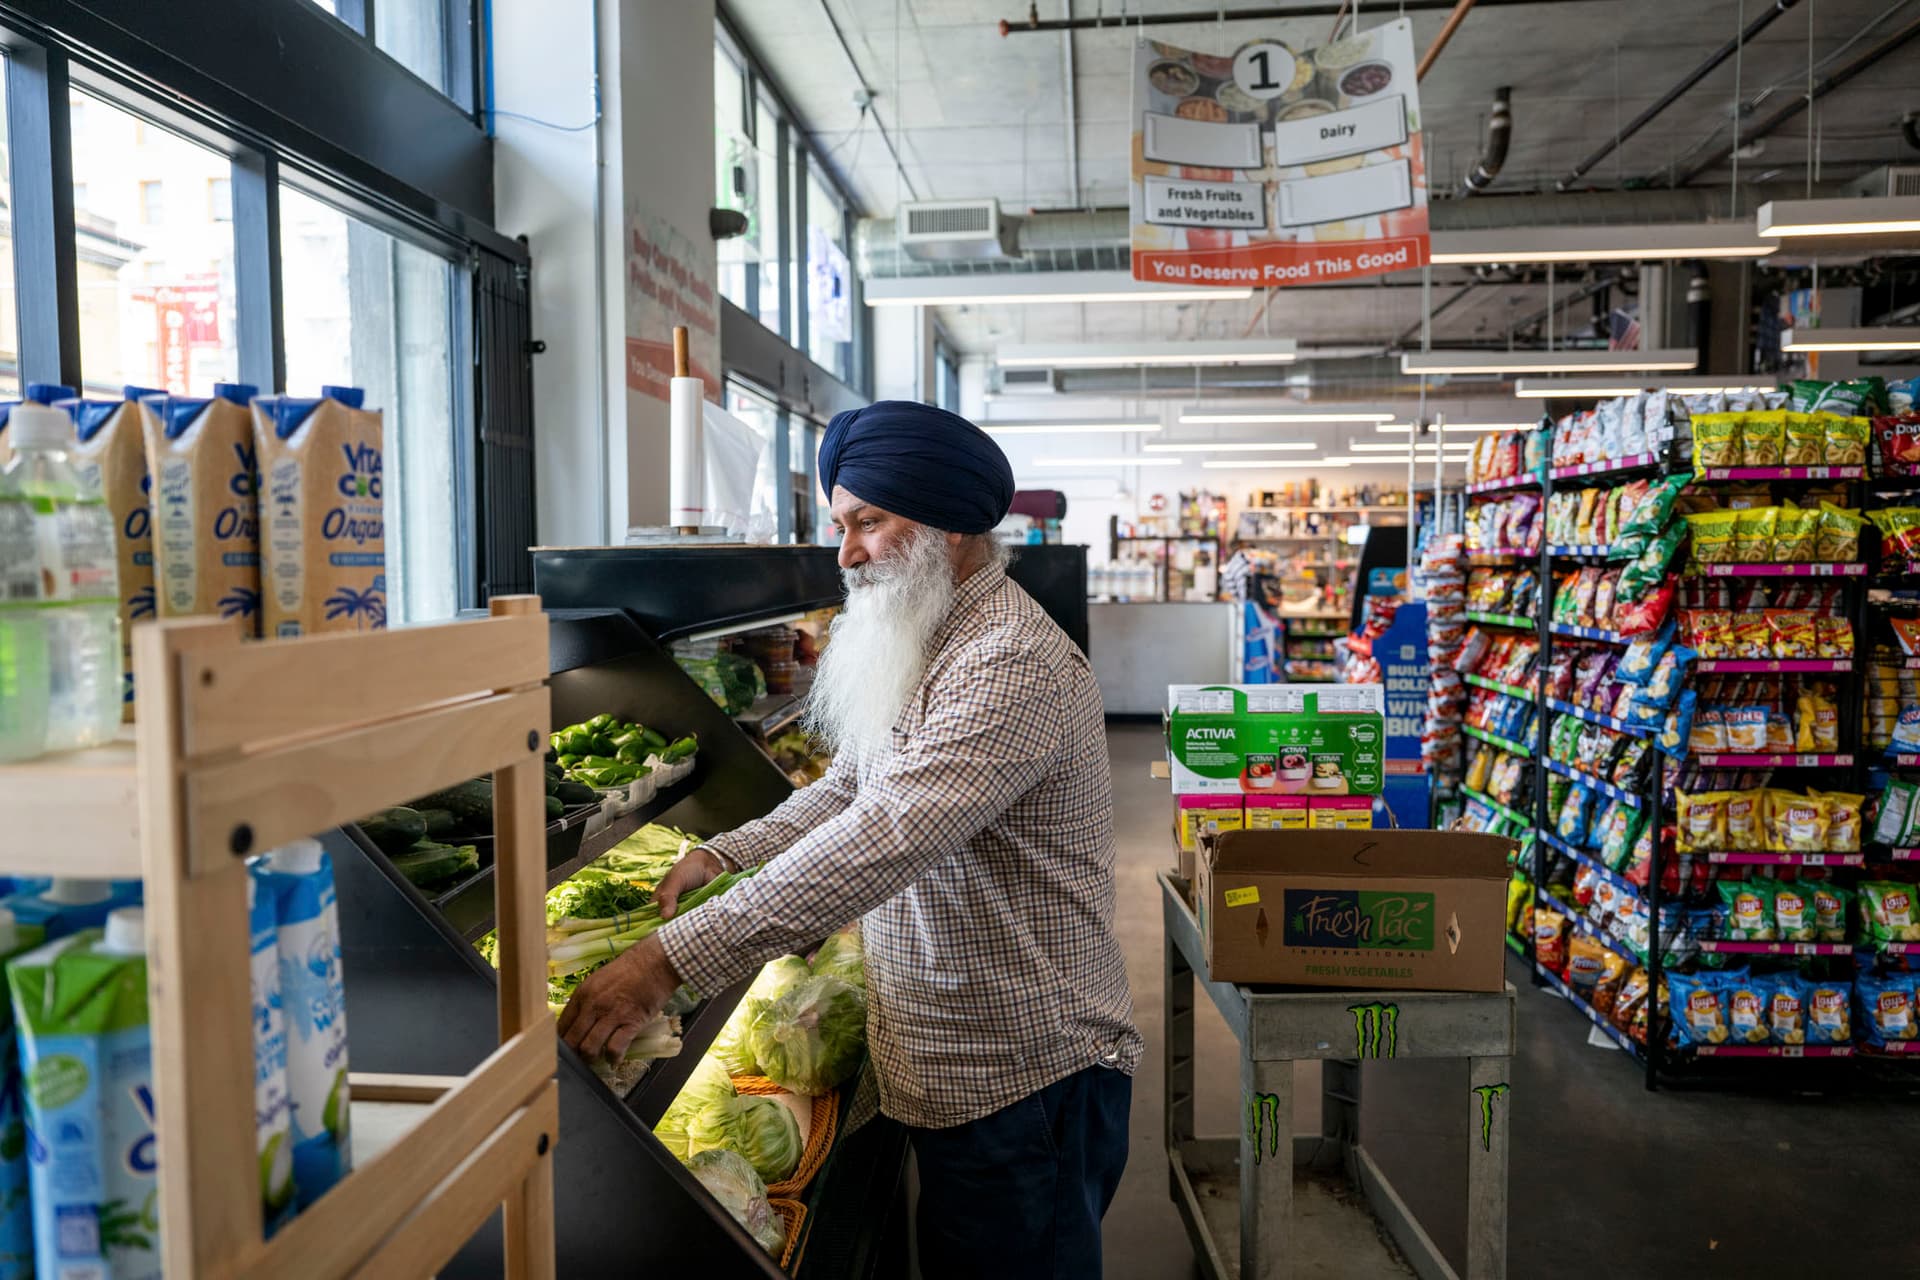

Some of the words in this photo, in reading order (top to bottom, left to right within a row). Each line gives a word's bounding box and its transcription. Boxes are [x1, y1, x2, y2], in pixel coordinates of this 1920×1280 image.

[1248, 51, 1280, 91] 1
[1320, 122, 1357, 140] Dairy
[1168, 188, 1203, 201] Fresh
[1206, 189, 1243, 203] Fruits
[1158, 206, 1182, 219] and
[1184, 207, 1255, 223] Vegetables
[1152, 261, 1185, 277] You
[1190, 264, 1259, 280] Deserve
[1264, 263, 1310, 280] Food
[1315, 260, 1352, 275] This
[1357, 248, 1407, 269] Good
[1712, 565, 1733, 575] NEW
[1843, 564, 1864, 574] NEW
[1186, 728, 1235, 740] ACTIVIA
[1299, 896, 1374, 942] Fresh
[1372, 897, 1428, 941] Pac
[1292, 949, 1426, 959] INTERNATIONAL
[1305, 965, 1341, 976] FRESH
[1344, 965, 1414, 978] VEGETABLES
